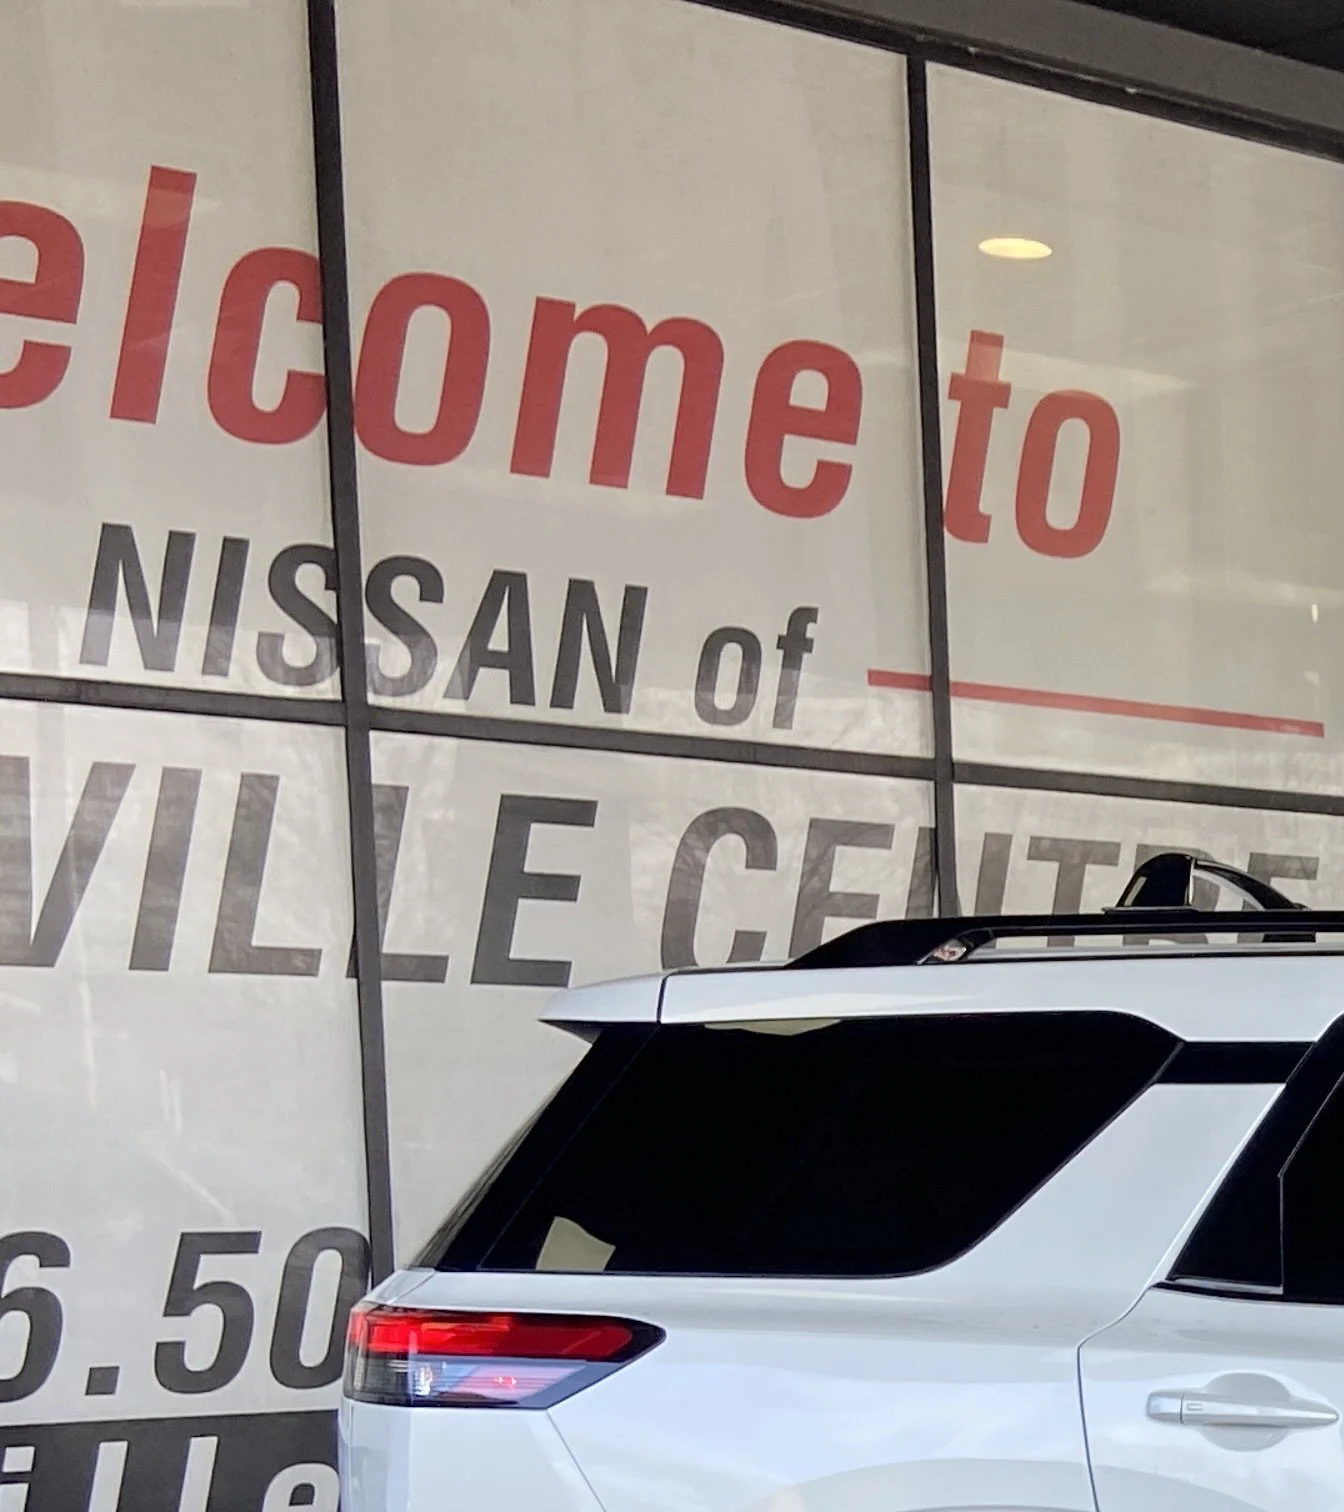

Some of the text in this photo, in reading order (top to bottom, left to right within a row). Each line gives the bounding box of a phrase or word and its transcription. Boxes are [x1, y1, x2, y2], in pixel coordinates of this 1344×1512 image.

[0, 165, 1122, 559] elcome to
[78, 521, 818, 731] NISSAN of
[0, 755, 600, 988] VILLE
